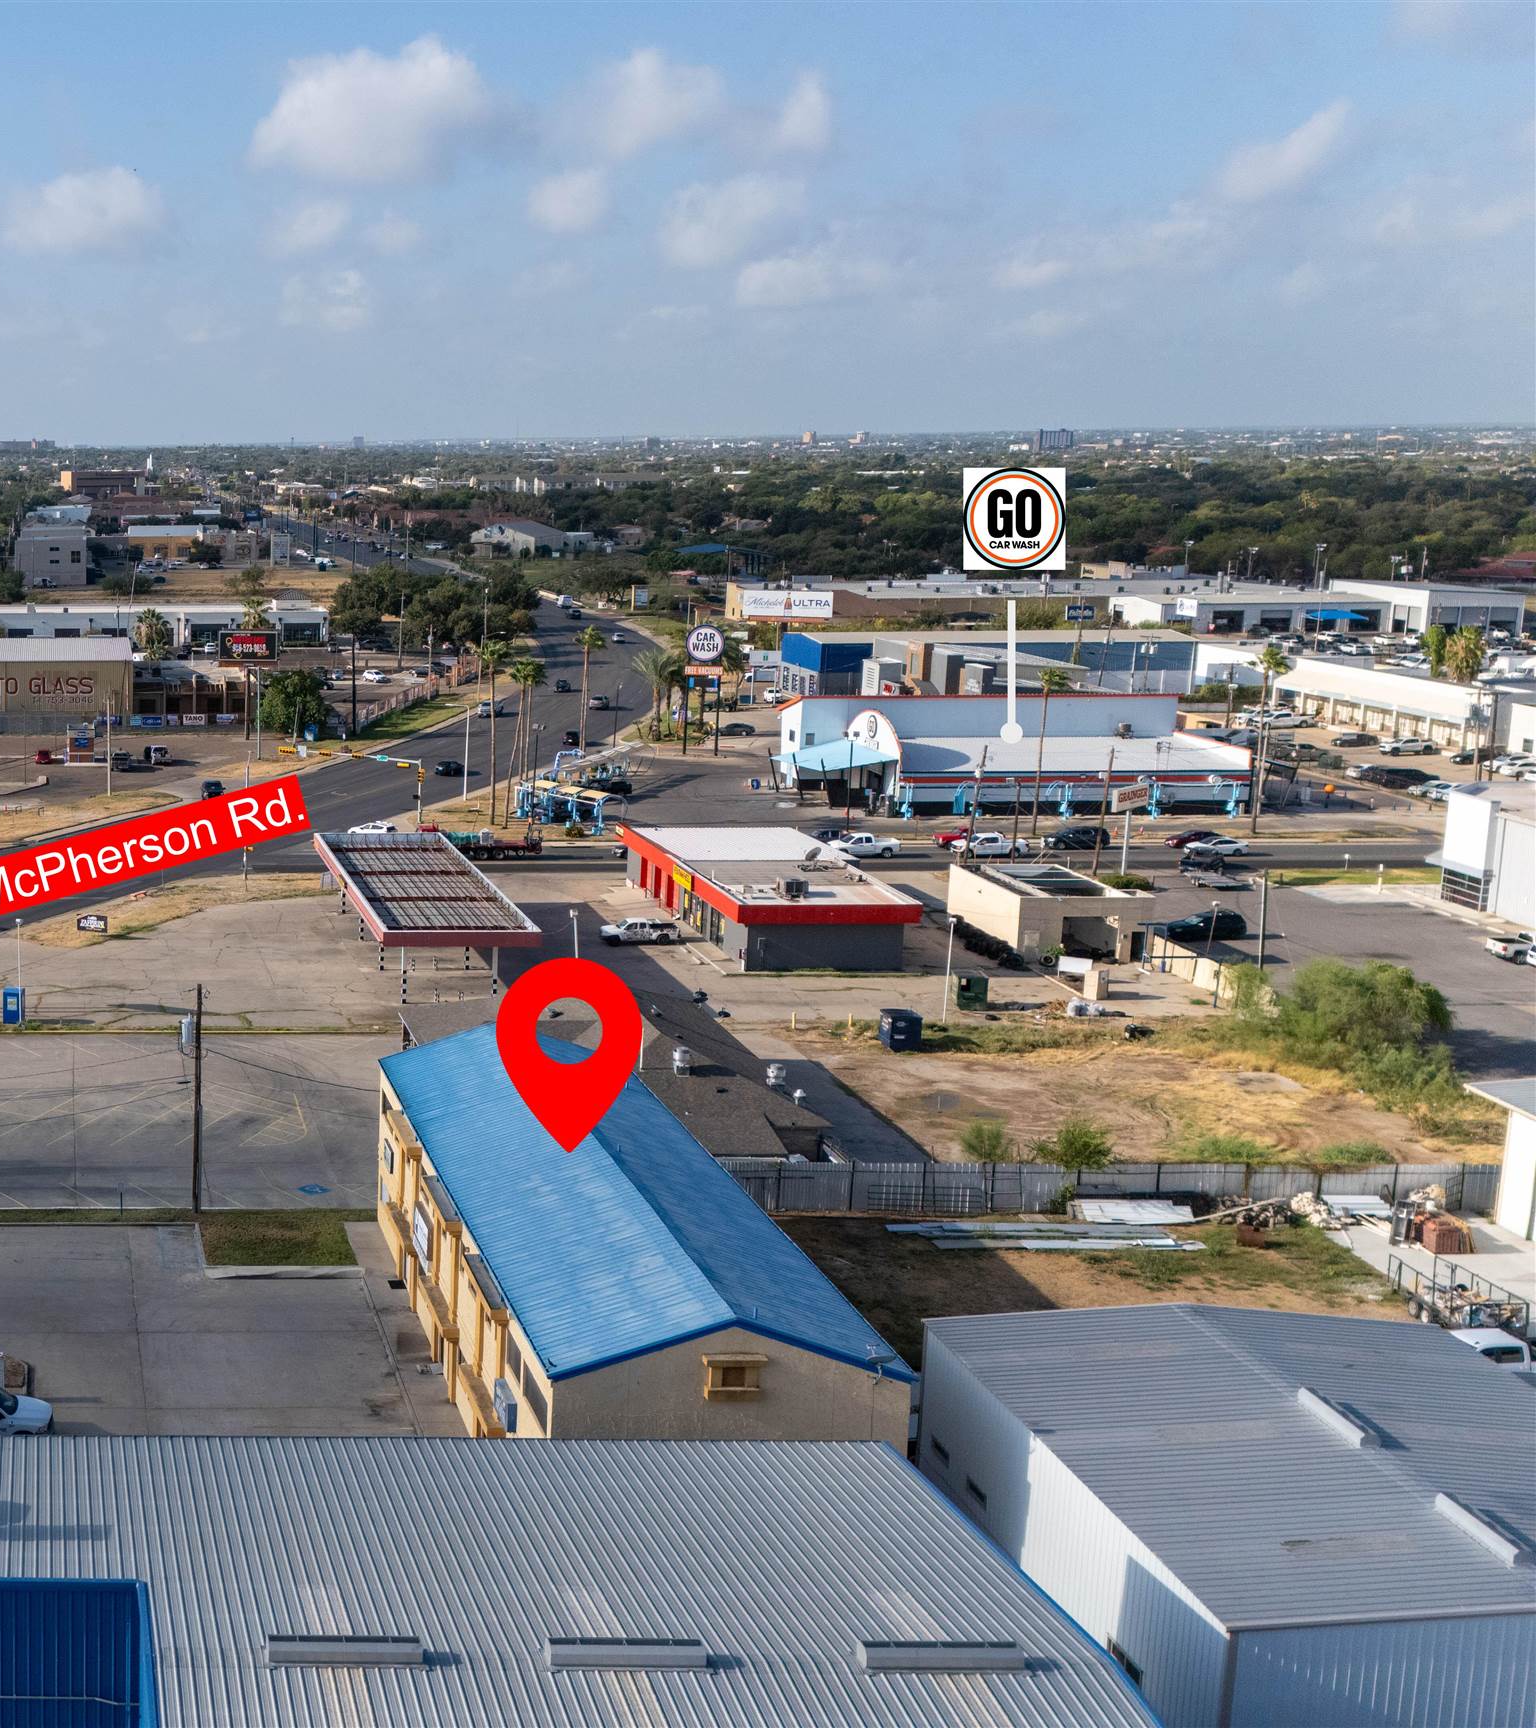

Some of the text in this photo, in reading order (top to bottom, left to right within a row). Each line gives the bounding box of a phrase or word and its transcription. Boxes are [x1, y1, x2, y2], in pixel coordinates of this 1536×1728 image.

[793, 599, 831, 607] ULTRA
[696, 632, 716, 642] CAR
[692, 642, 719, 652] WASH
[29, 677, 94, 696] GLASS
[1119, 787, 1148, 803] GRAINGER
